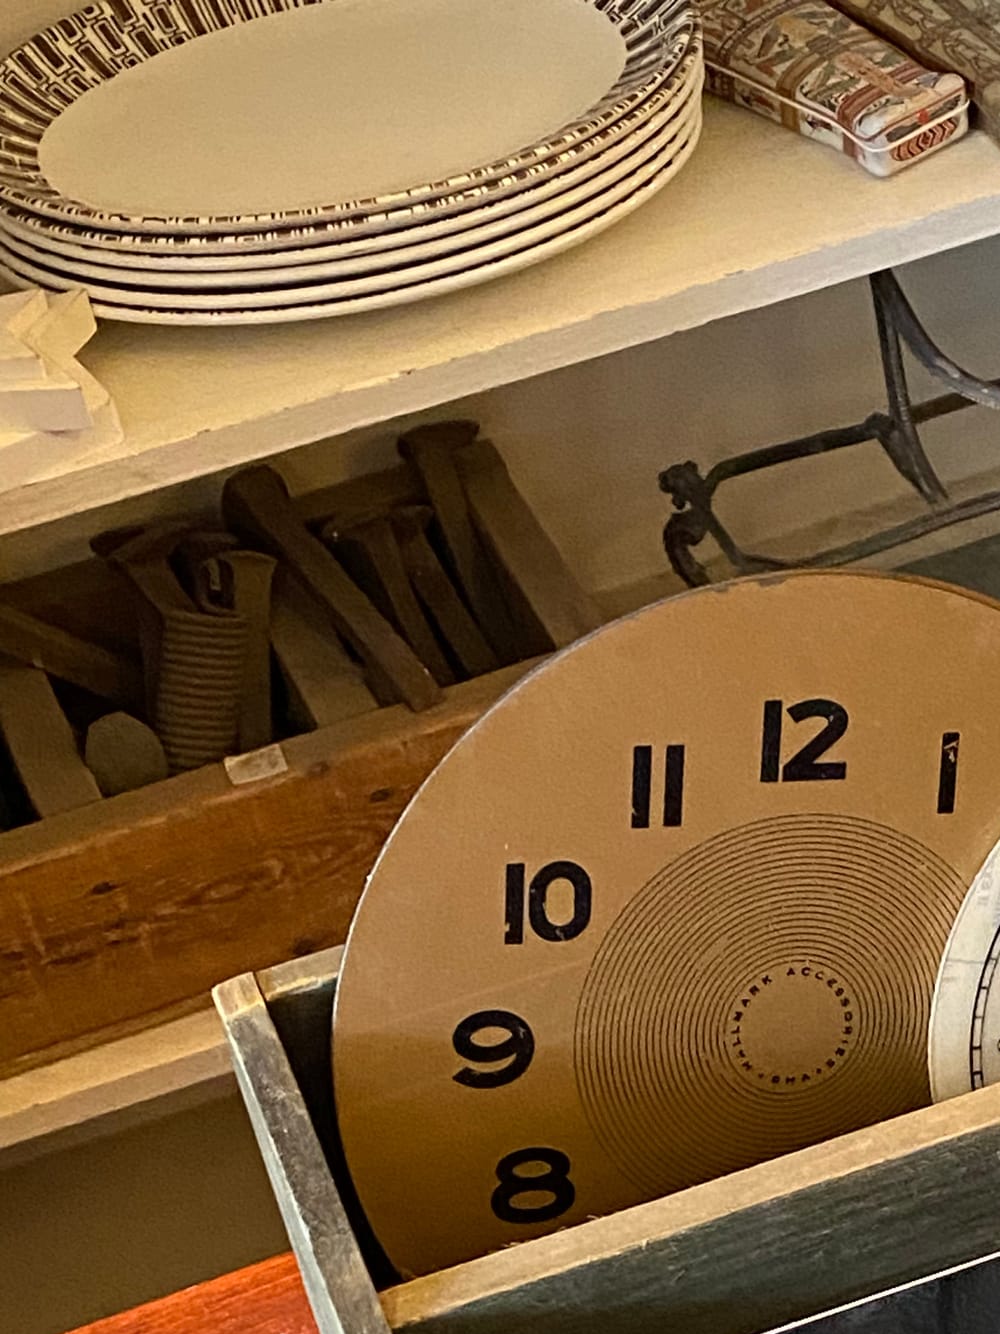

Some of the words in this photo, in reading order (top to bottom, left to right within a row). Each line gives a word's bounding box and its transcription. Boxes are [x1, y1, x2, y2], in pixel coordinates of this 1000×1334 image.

[758, 698, 849, 783] 12
[936, 731, 960, 814] 1
[630, 743, 685, 829] 11
[503, 860, 593, 945] 10
[452, 1009, 536, 1090] 9
[490, 1146, 576, 1225] 8
